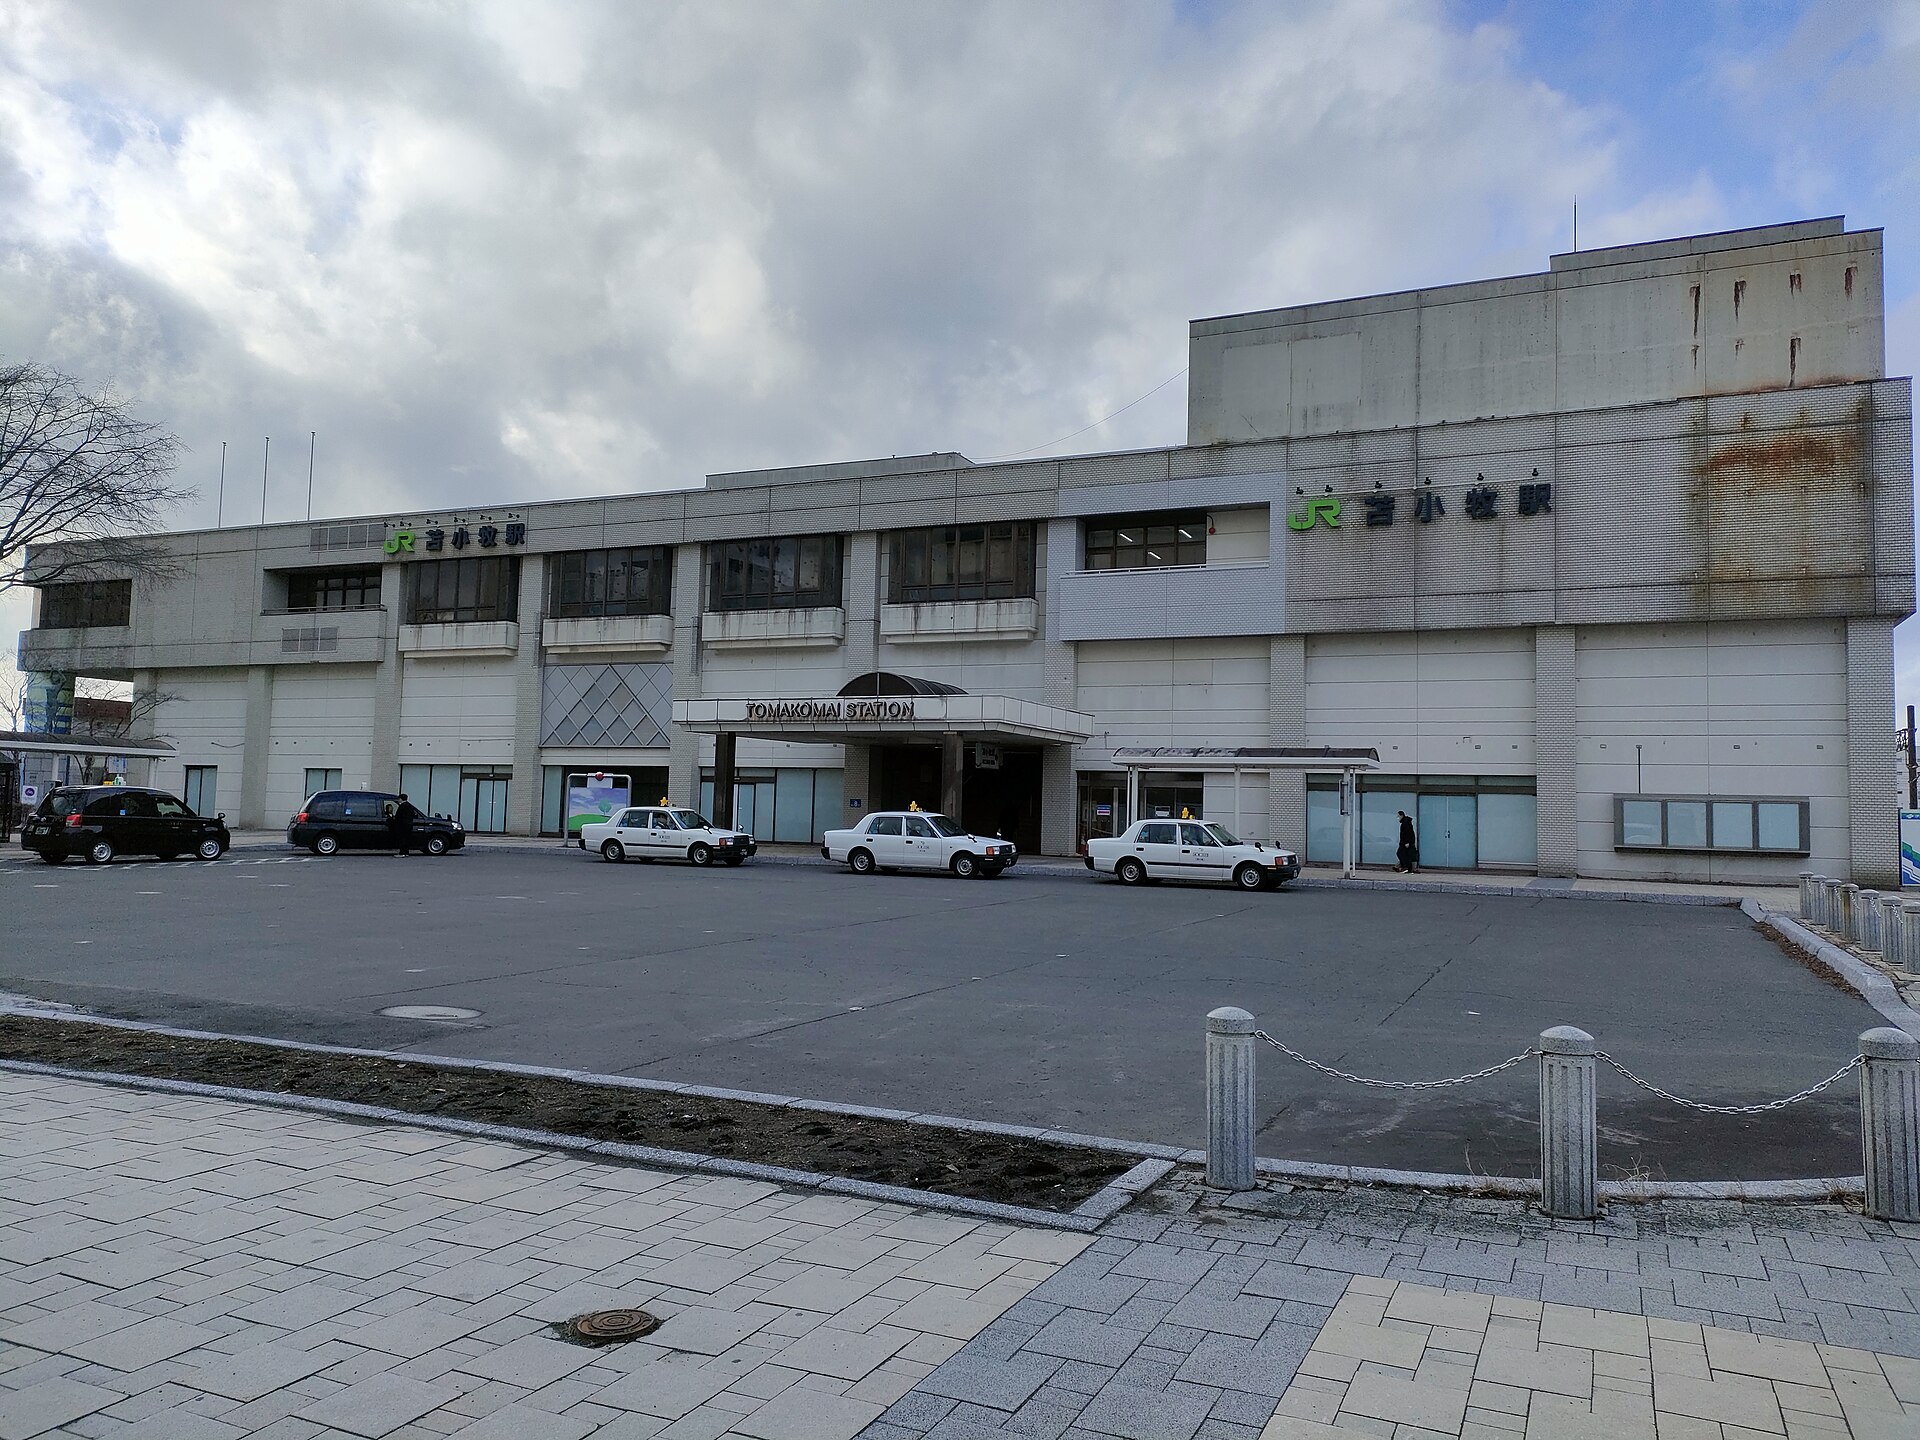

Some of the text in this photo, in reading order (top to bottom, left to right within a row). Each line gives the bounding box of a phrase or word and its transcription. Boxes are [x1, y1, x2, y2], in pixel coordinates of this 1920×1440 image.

[1288, 483, 1551, 530] JR 苫小牧駅
[384, 523, 525, 553] JR 苫小牧駅
[747, 702, 914, 718] TOMAKOMAI STATION
